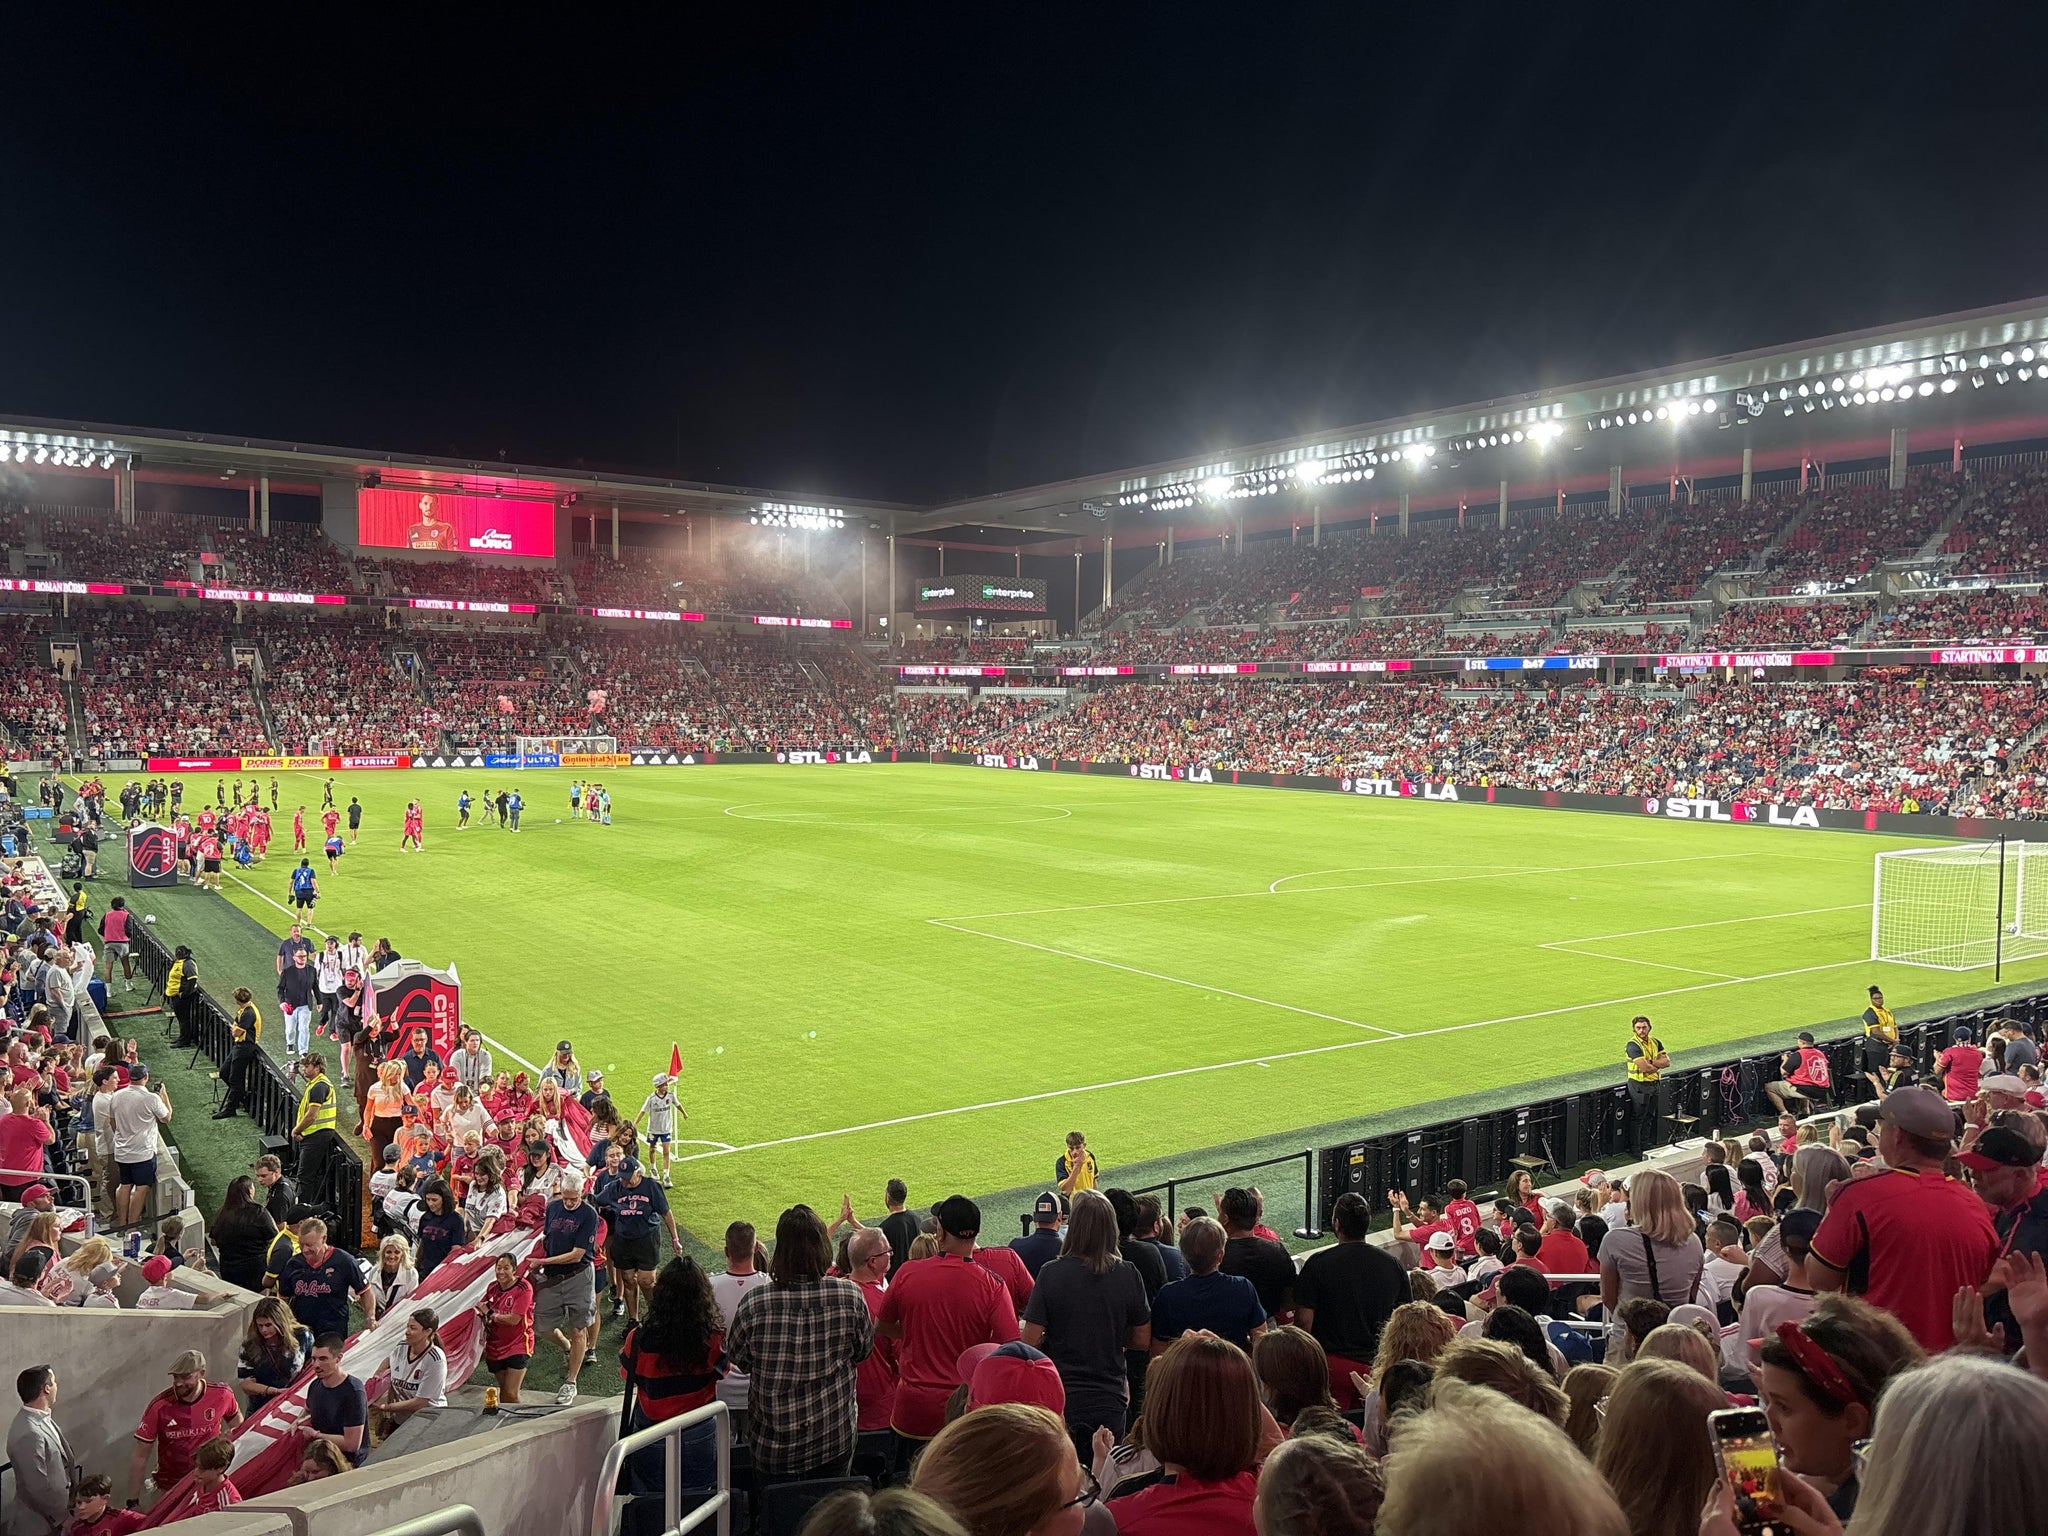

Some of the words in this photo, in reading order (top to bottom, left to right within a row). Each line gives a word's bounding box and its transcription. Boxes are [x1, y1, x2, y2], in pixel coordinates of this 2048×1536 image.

[35, 581, 62, 592] ROMAN
[206, 589, 240, 600] STARTING
[922, 588, 955, 598] enterprise
[983, 588, 1034, 598] enterprise
[1667, 656, 1704, 666] STARTING
[1736, 656, 1766, 666] ROMAN
[1766, 654, 1792, 666] BÜRKI
[1941, 651, 1992, 662] STARTING
[1992, 650, 2004, 662] XI
[1471, 660, 1488, 670] STL
[1569, 658, 1594, 669] LAFC
[562, 755, 605, 764] Continental
[788, 752, 826, 764] STL
[846, 751, 872, 764] LA
[984, 754, 1008, 768] STL
[1020, 756, 1039, 770] LA
[1140, 764, 1172, 780] STL
[1188, 768, 1213, 783] LA
[1356, 778, 1400, 796] STL
[1424, 782, 1459, 800] LA
[1666, 798, 1732, 821] STL
[1744, 806, 1758, 819] VS
[1768, 804, 1820, 828] LA
[162, 837, 170, 865] CITY
[448, 1002, 454, 1014] ST
[434, 994, 448, 1050] CITY
[628, 1195, 650, 1203] LOUIS
[1456, 1207, 1472, 1217] ENZO
[1461, 1218, 1474, 1235] 8
[176, 1426, 213, 1438] PURINA
